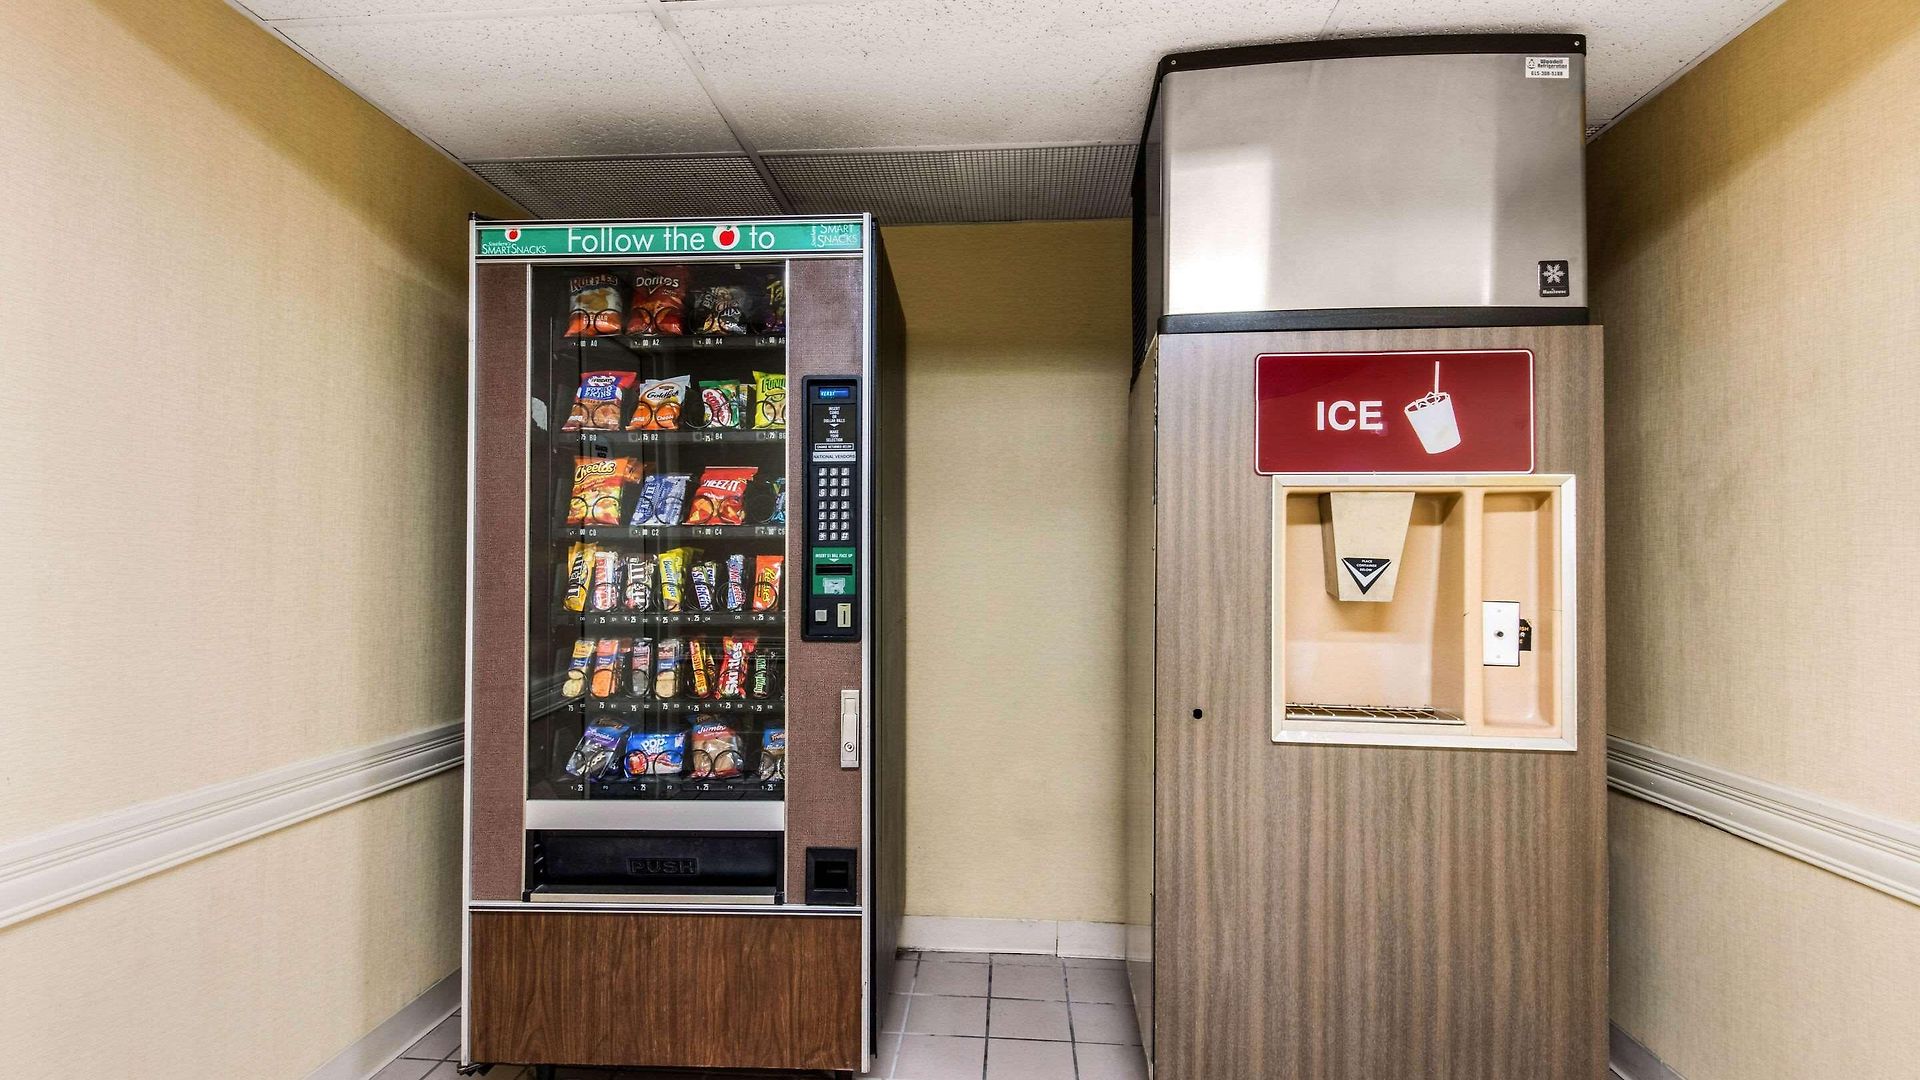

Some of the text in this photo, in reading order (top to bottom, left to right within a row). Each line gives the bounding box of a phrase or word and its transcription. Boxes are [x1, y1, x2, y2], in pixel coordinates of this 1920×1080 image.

[820, 224, 854, 234] SMART
[568, 225, 775, 253] Follow the to
[817, 233, 857, 248] SNACKS
[636, 276, 679, 288] Doritos
[1316, 400, 1384, 431] ICE
[574, 460, 616, 482] Cheetos
[631, 860, 695, 874] PUSH
